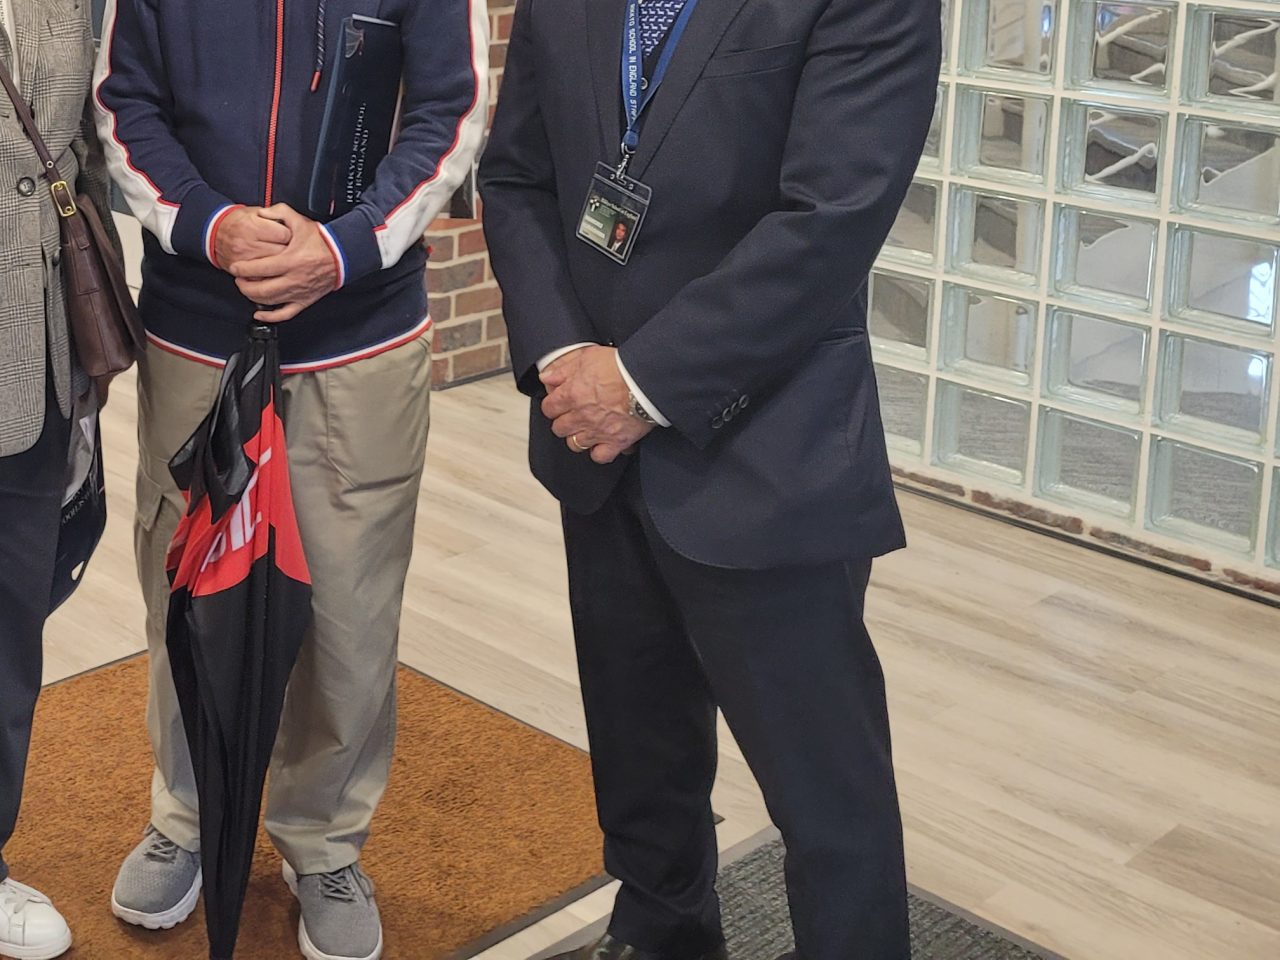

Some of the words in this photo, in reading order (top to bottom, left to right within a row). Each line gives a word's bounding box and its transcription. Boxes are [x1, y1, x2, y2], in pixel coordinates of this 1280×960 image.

[629, 65, 637, 97] ENGLAND
[346, 154, 356, 203] RIKKYO
[352, 102, 366, 151] SCHOOL
[356, 129, 368, 186] ENGLAND
